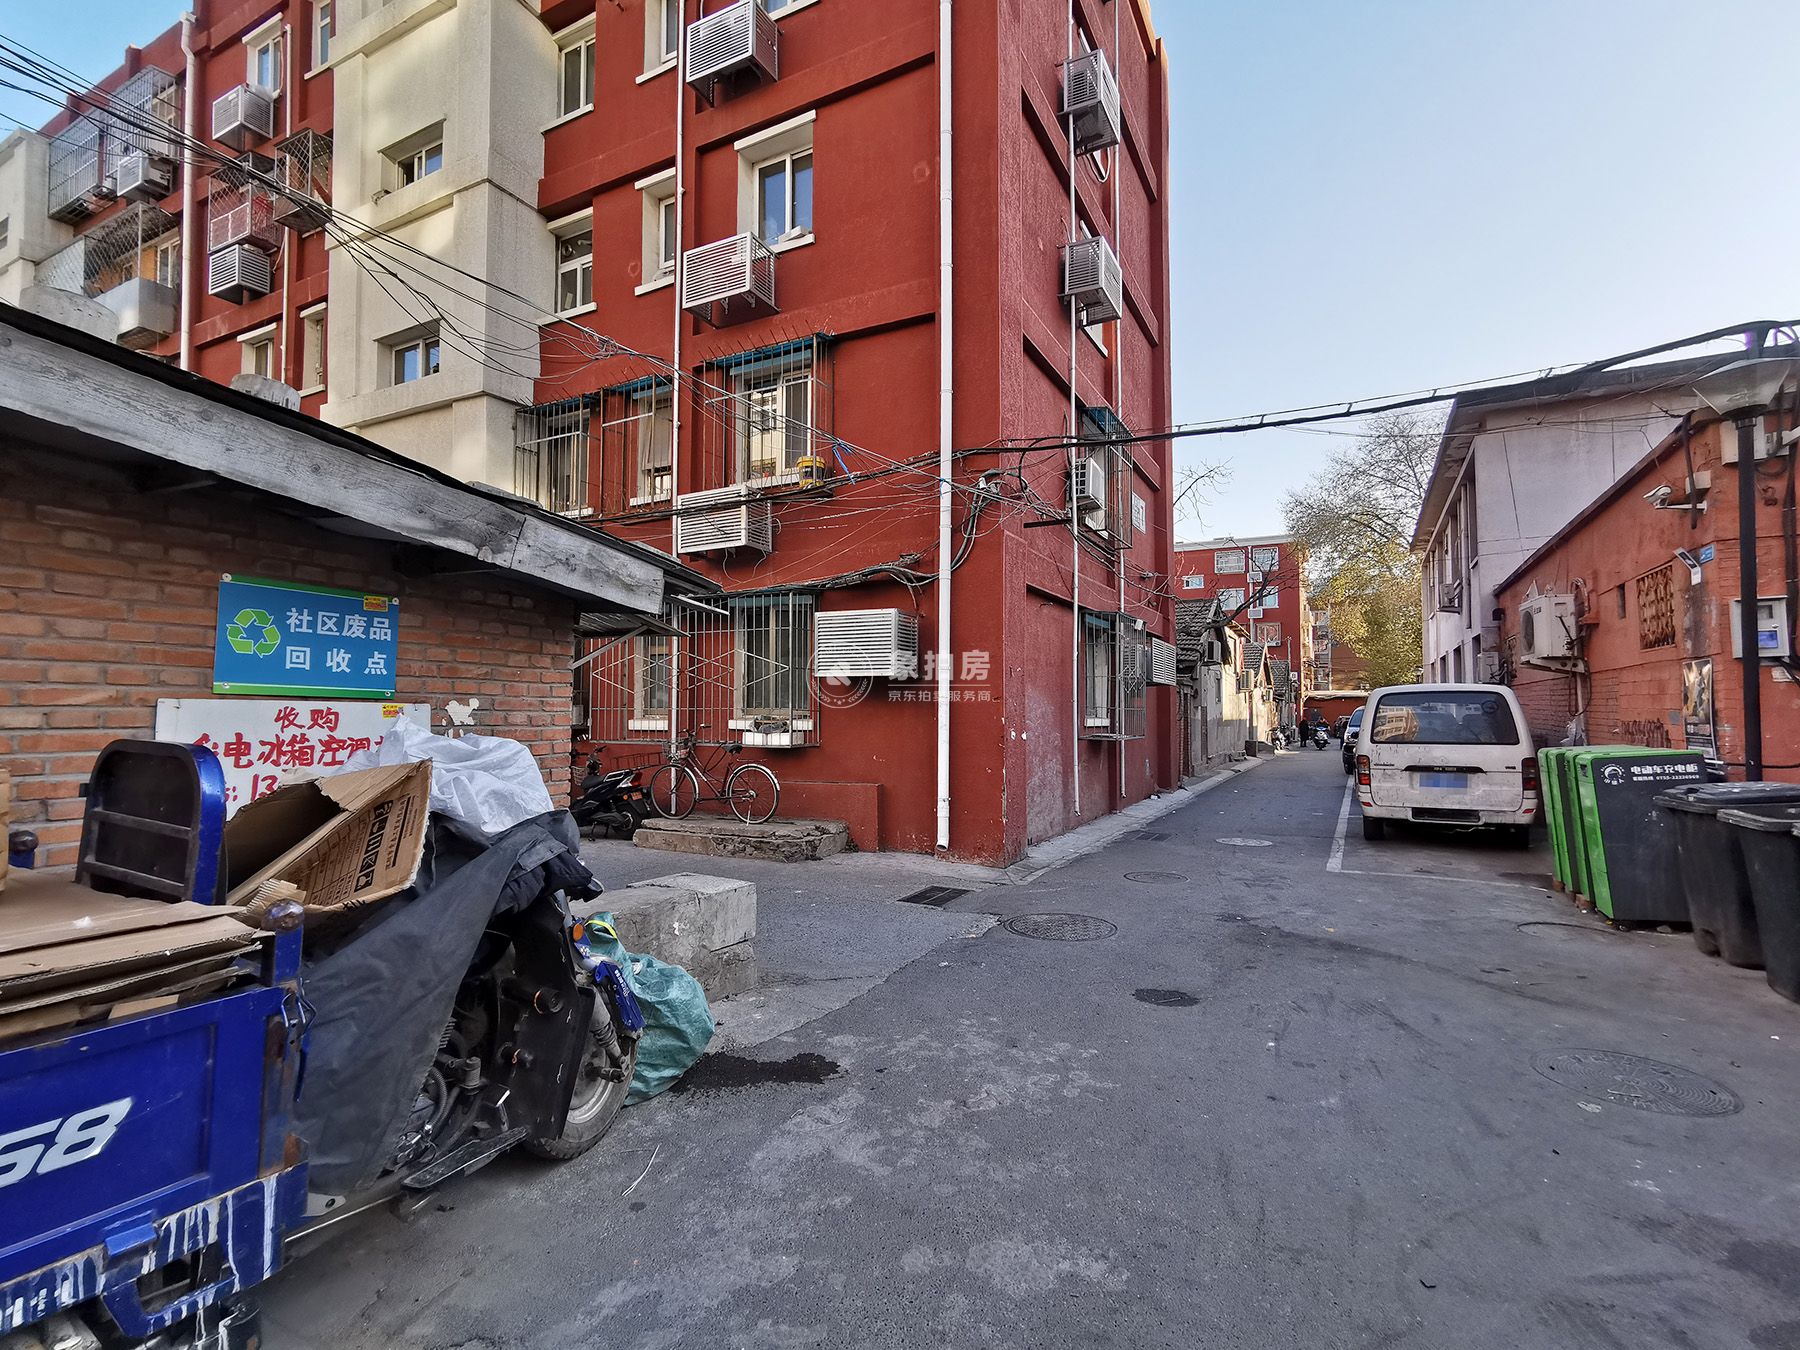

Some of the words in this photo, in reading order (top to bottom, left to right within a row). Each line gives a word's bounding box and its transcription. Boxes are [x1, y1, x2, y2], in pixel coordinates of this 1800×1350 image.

[286, 607, 392, 641] 社区废品
[285, 645, 388, 675] 回收点
[274, 706, 340, 733] 收购
[193, 732, 384, 769] 电冰箱空调
[1630, 763, 1699, 775] 电动车充电柜
